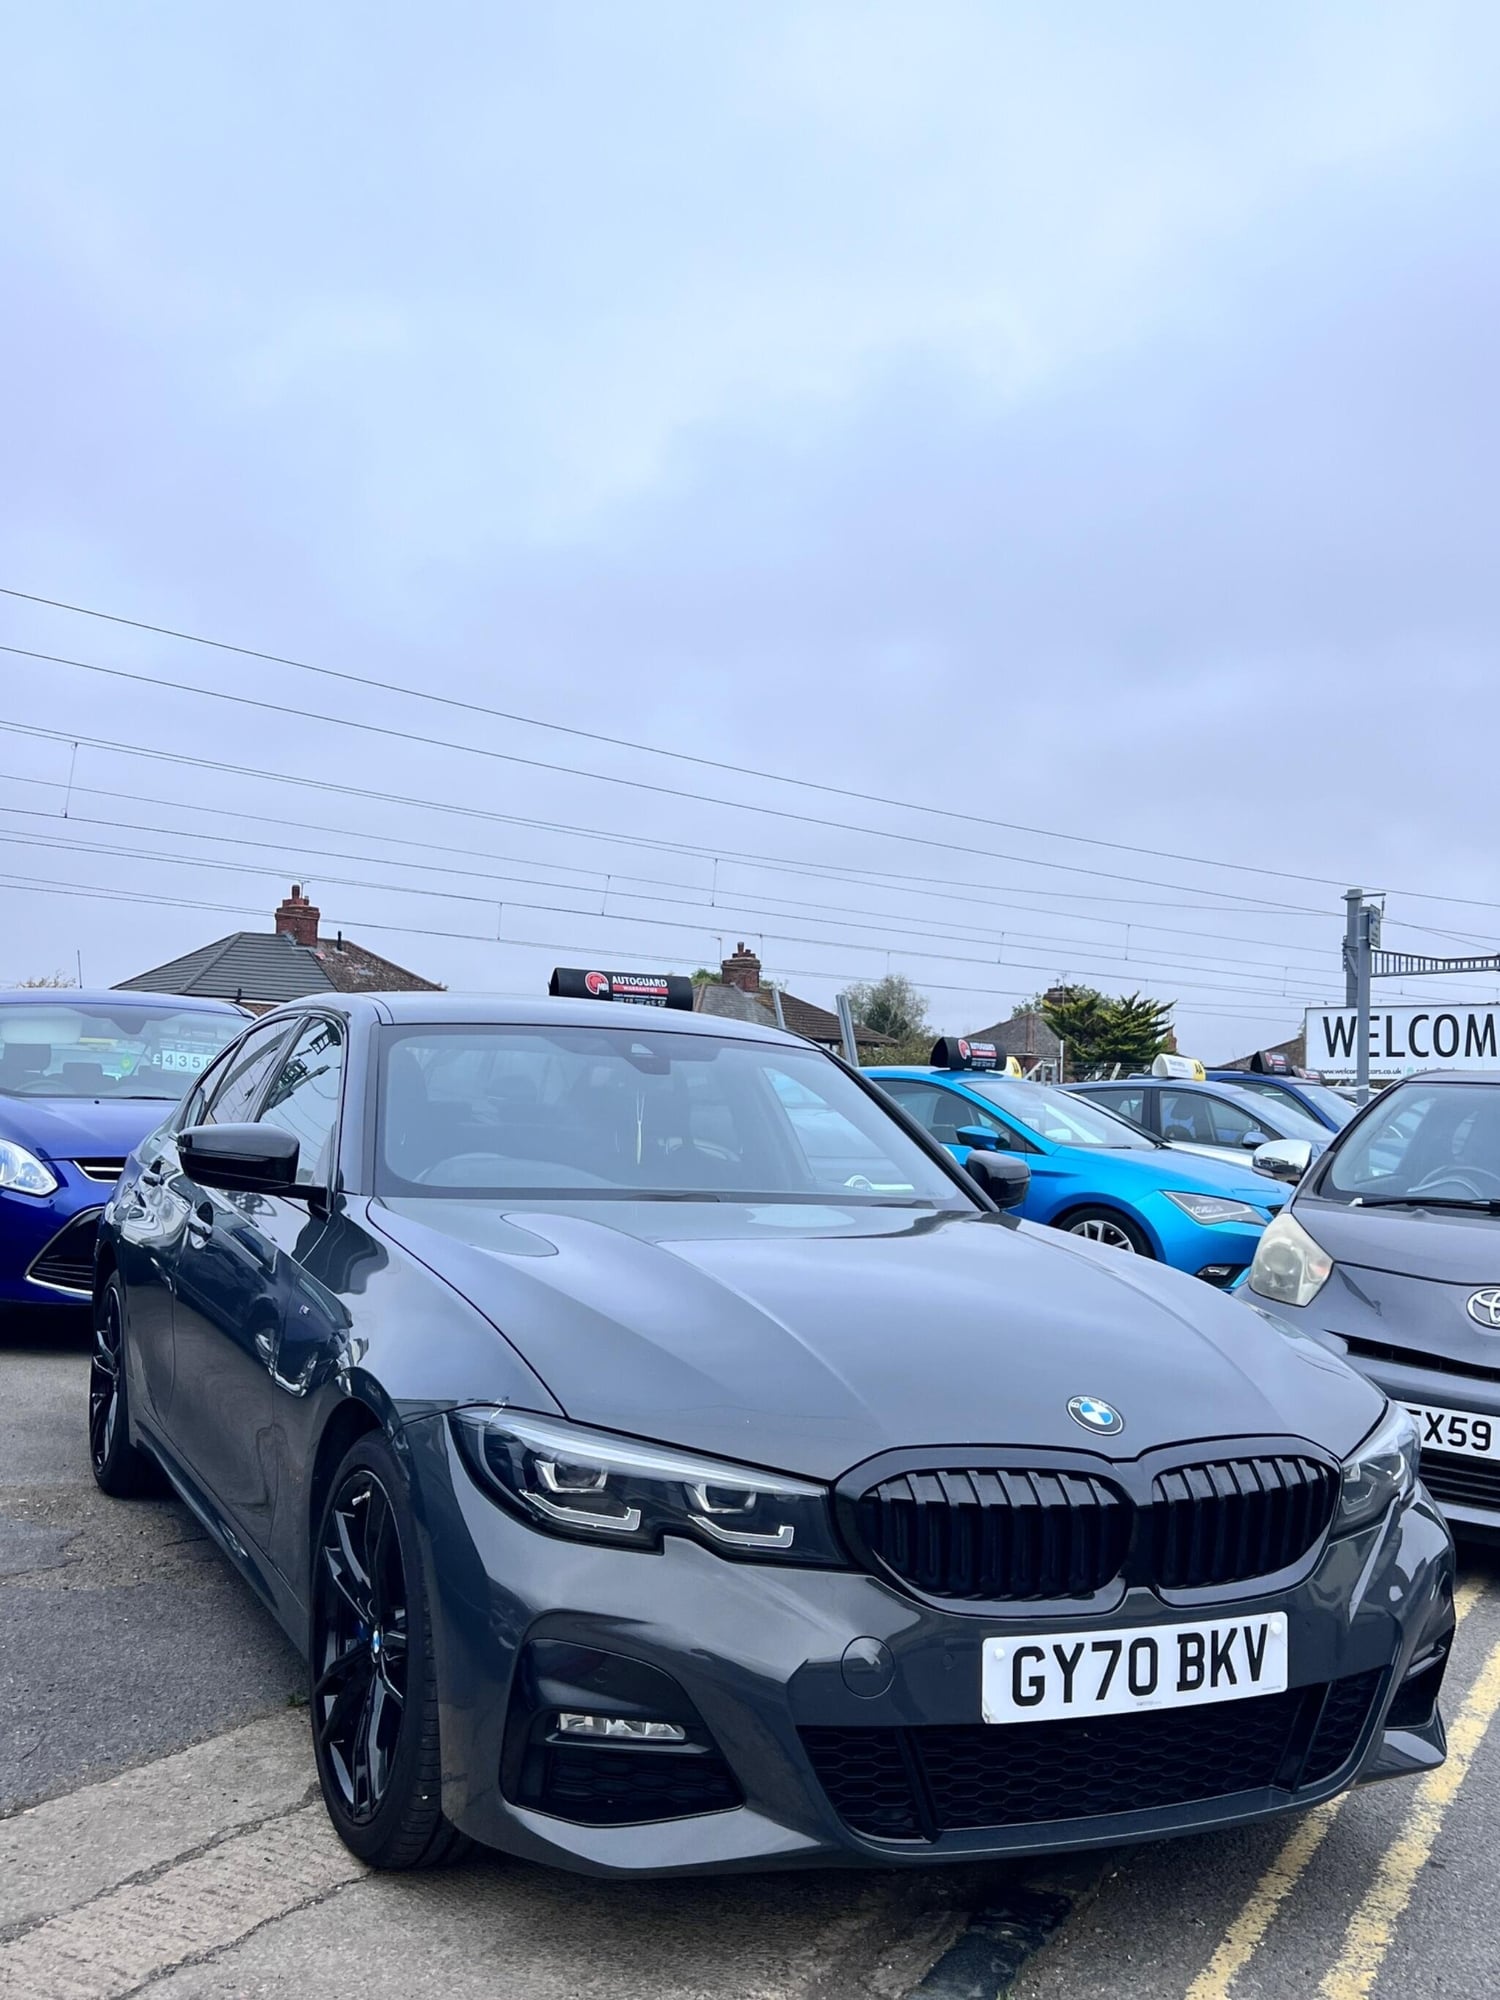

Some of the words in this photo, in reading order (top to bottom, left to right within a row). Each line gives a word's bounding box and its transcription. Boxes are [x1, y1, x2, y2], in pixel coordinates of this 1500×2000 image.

[612, 976, 668, 988] AUTOGUARD
[1011, 1636, 1158, 1707] GY70
[1176, 1623, 1268, 1692] BKV
